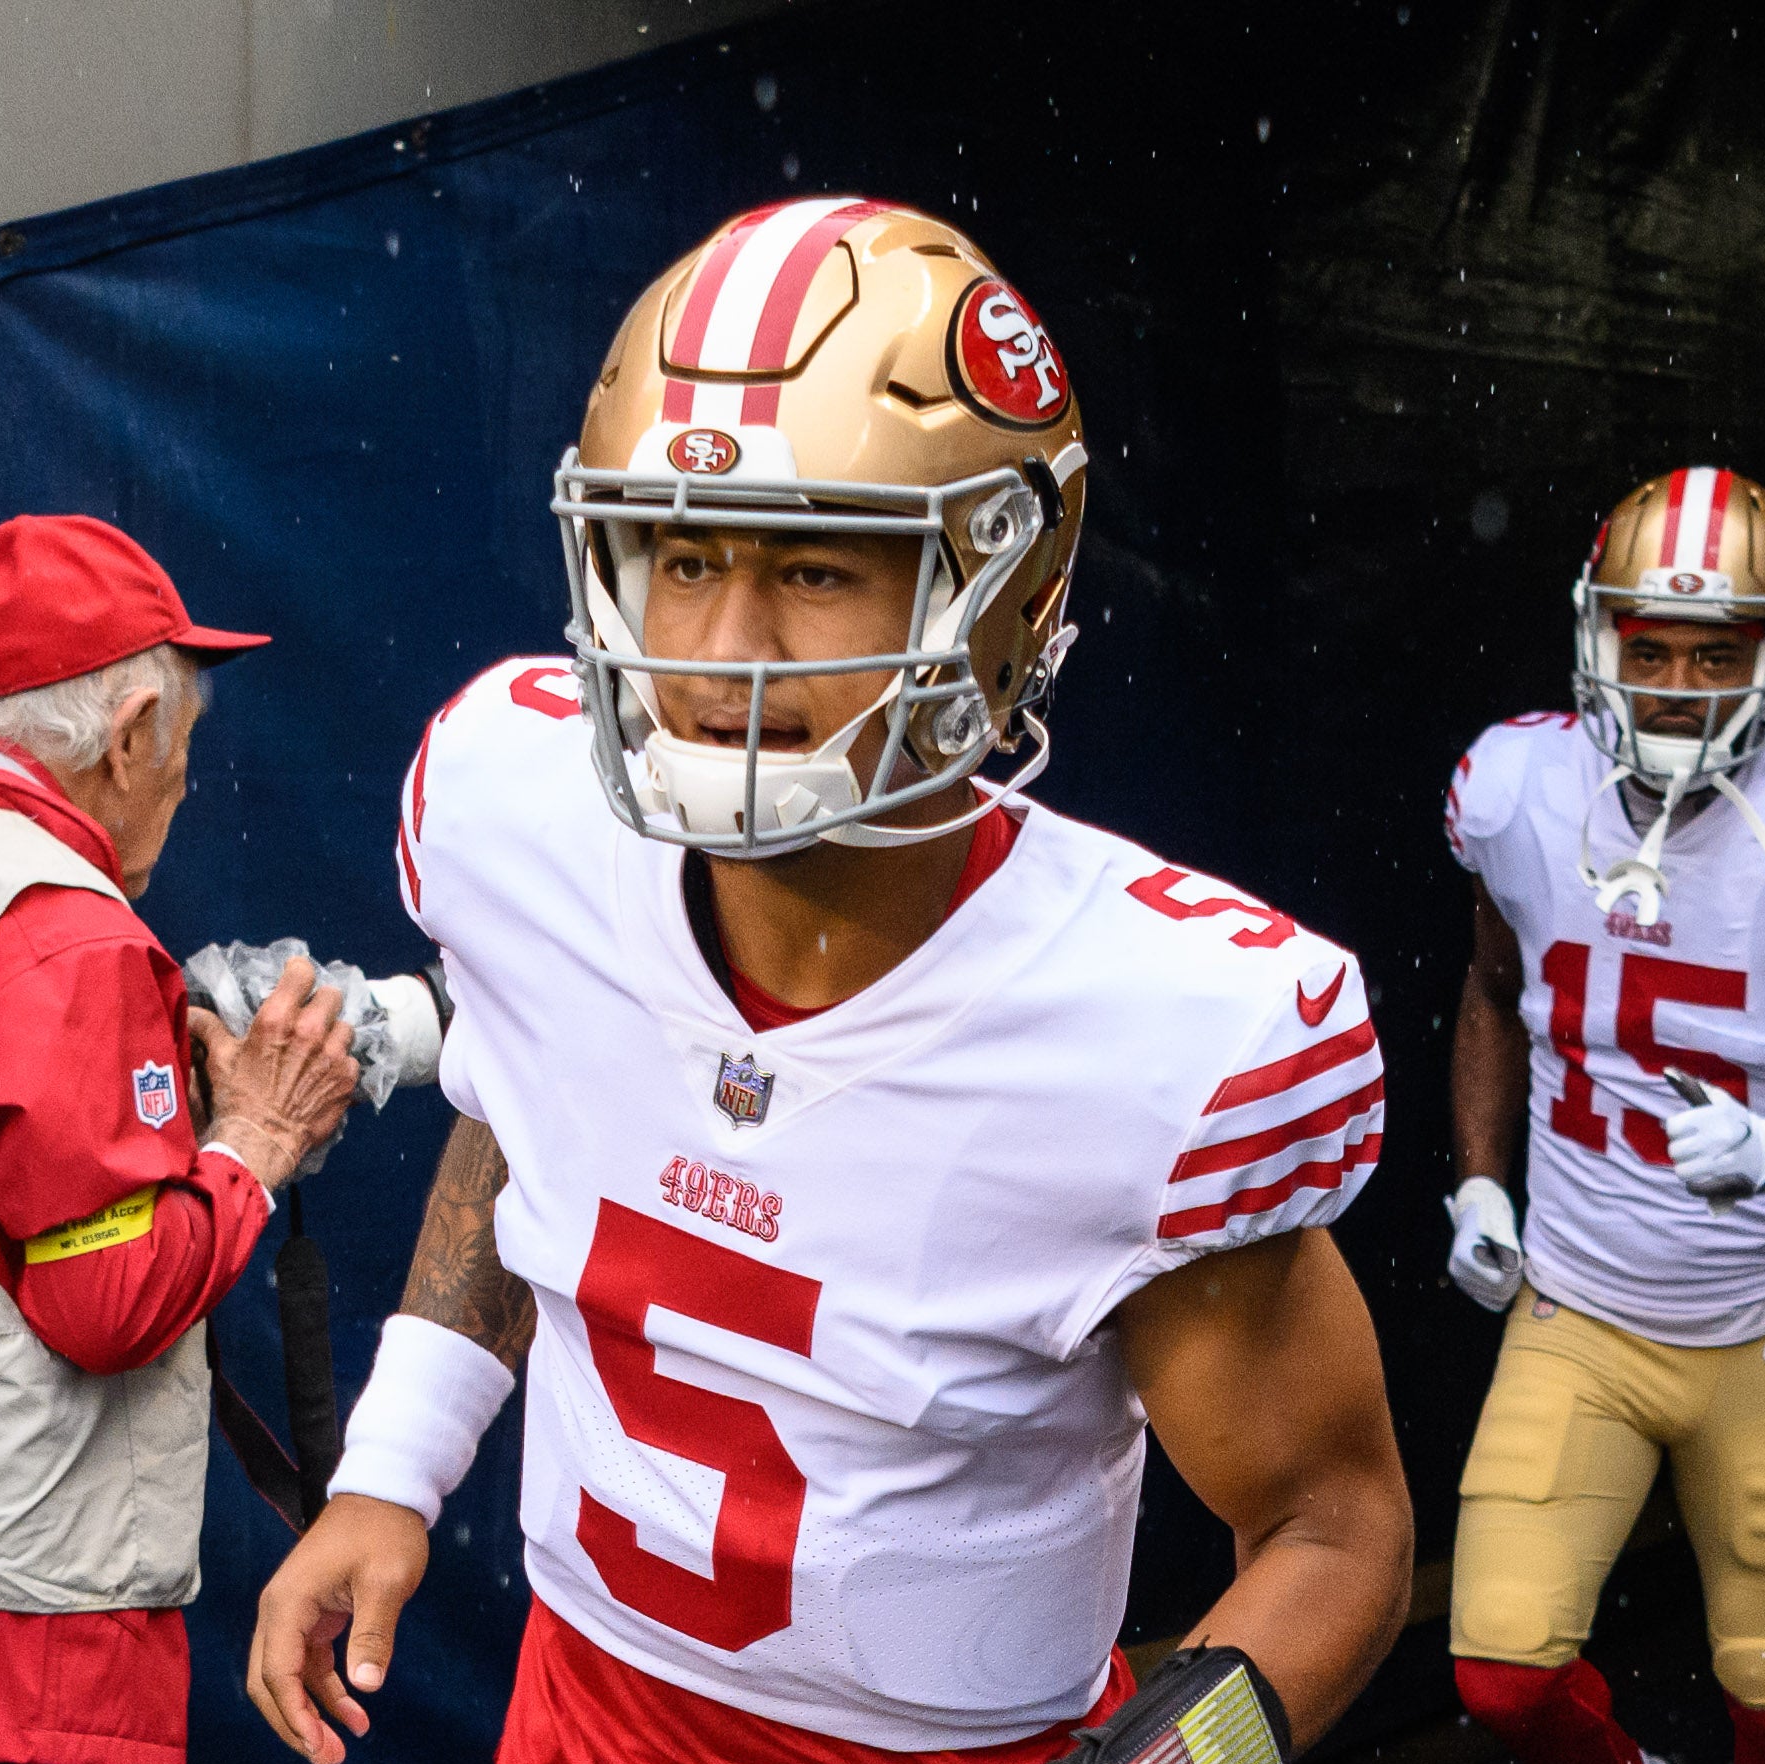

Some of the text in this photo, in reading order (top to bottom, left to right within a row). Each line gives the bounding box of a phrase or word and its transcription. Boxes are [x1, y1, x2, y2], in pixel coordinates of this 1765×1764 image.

[684, 433, 727, 472] SF
[1541, 939, 1750, 1167] 15
[142, 1091, 171, 1117] NFL
[721, 1081, 759, 1117] NFL
[660, 1155, 783, 1243] 49ERS
[574, 1196, 824, 1653] 5
